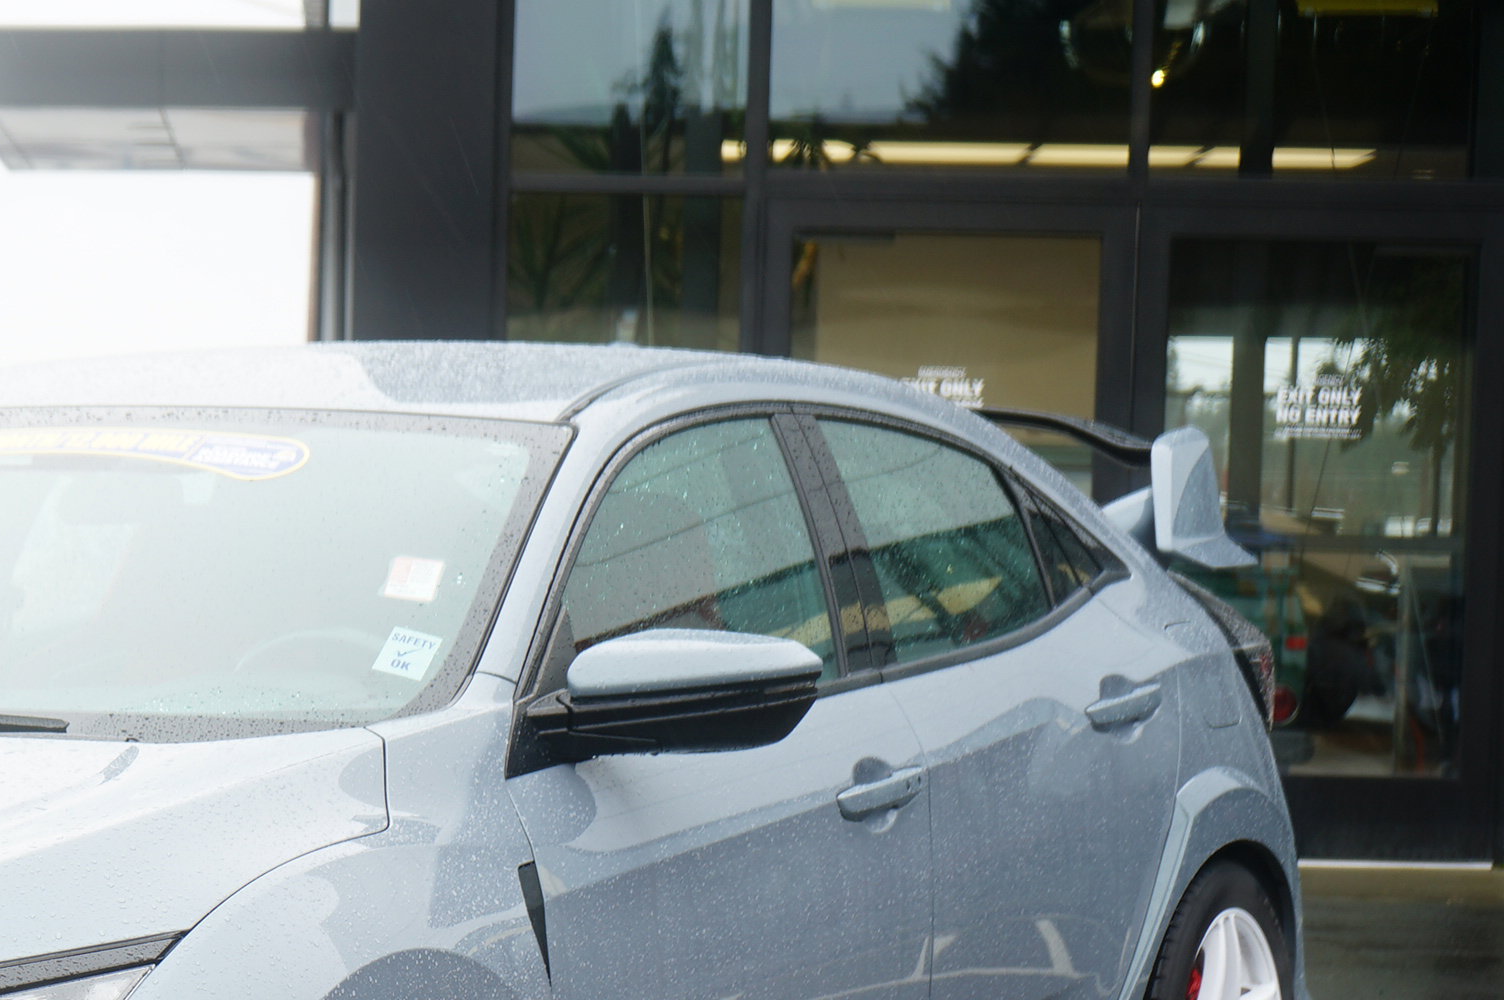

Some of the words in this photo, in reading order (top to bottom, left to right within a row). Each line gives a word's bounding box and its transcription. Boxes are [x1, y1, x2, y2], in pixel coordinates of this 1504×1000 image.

[940, 378, 984, 397] ONLY
[1276, 386, 1314, 405] EXIT
[1318, 386, 1363, 405] ONLY
[1276, 406, 1301, 424] NO
[1305, 407, 1362, 425] ENTRY
[391, 632, 437, 650] SAFETY
[390, 659, 411, 671] OK
